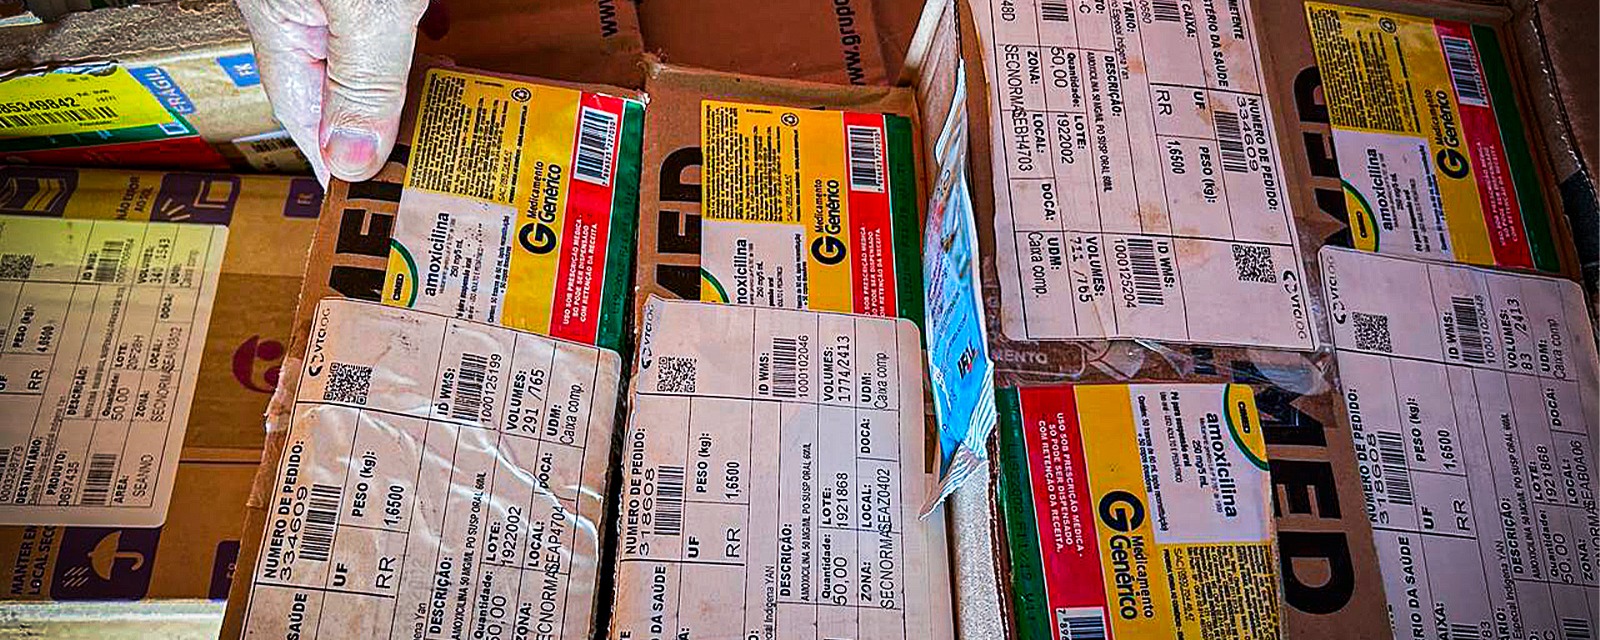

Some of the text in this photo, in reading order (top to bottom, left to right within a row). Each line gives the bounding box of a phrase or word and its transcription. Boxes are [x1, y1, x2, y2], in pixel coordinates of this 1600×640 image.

[833, 0, 866, 85] ww.grupo
[1183, 4, 1196, 38] CAIXA:
[1027, 51, 1040, 84] ZONA:
[1050, 47, 1068, 88] 50,00
[1067, 52, 1080, 107] Quantidade:
[1210, 34, 1228, 87] DA SAÚDE
[1104, 55, 1120, 117] DESCRIÇÃO:
[1156, 89, 1171, 116] RR
[1194, 91, 1205, 110] UF
[1033, 113, 1045, 153] LOCAL:
[1056, 112, 1074, 164] 1922002
[1074, 115, 1086, 149] LOTE:
[1237, 96, 1258, 172] 334609
[1424, 89, 1443, 145] Medicamento
[1436, 90, 1460, 147] Genérico
[1166, 140, 1185, 175] 1,6500
[1199, 146, 1212, 176] PESO
[1248, 98, 1278, 210] NUMERO DE PEDIDO:
[1436, 148, 1469, 179] G
[527, 161, 544, 219] Medicamento
[538, 164, 562, 224] Genérico
[814, 179, 824, 233] Medicamento
[822, 179, 841, 234] Genérico
[1041, 183, 1055, 221] DOCA:
[1366, 148, 1394, 231] amoxicilina
[423, 212, 449, 296] amoxicilina
[518, 223, 557, 255] G
[810, 236, 846, 265] G
[1027, 232, 1043, 262] Caixa
[1047, 237, 1061, 271] UDM:
[1073, 270, 1093, 303] /765
[1086, 237, 1105, 296] VOLUMES:
[1114, 239, 1136, 308] 1000125204
[1161, 257, 1174, 288] WMS:
[1444, 312, 1458, 343] WMS:
[1500, 309, 1518, 369] VOLUMES:
[759, 353, 769, 395] ID WMS:
[798, 335, 809, 398] 1000102046
[824, 347, 834, 401] VOLUMES:
[837, 335, 851, 402] 1774/2413
[1520, 353, 1534, 371] 83
[1538, 339, 1551, 372] UDM:
[28, 370, 45, 390] RR
[439, 368, 456, 399] WMS:
[481, 354, 502, 424] 1000125199
[506, 370, 526, 430] VOLUMES:
[522, 369, 544, 434] 291 /765
[861, 372, 871, 403] UDM:
[546, 404, 562, 436] UDM:
[1546, 387, 1562, 427] DOCA:
[560, 416, 577, 444] Caixa
[861, 419, 870, 454] DOCA:
[1038, 420, 1048, 440] COM
[1412, 428, 1426, 462] PESO
[1437, 430, 1458, 470] 1,6500
[46, 450, 67, 495] PRODUTO:
[539, 453, 552, 488] DOCA:
[696, 433, 712, 493] PESO (kg):
[1041, 443, 1055, 492] RETENÇÃO
[1056, 413, 1078, 512] USO SOB PRESCRIÇÃO
[1206, 412, 1237, 518] amoxicilina
[1348, 388, 1378, 522] NUMERO PEDIDO:
[1537, 445, 1558, 504] 1921868
[352, 451, 377, 517] PESO (kg):
[626, 428, 646, 554] NUMERO DE PEDIDO:
[725, 462, 741, 499] 1,6500
[802, 482, 811, 501] SUSP
[836, 473, 848, 527] 1921868
[1051, 438, 1073, 545] PODE SER DISPENSADO
[1366, 432, 1390, 525] 318608
[1529, 461, 1543, 500] LOTE:
[1562, 459, 1579, 505] LOCAL:
[264, 440, 304, 578] NUMERO DE PEDIDO:
[384, 485, 404, 526] 1,6500
[640, 468, 654, 556] 318608
[802, 503, 810, 514] PO
[823, 487, 832, 525] LOTE:
[862, 484, 871, 528] LOCAL:
[1098, 490, 1145, 531] G
[1421, 506, 1434, 530] UF
[1453, 500, 1470, 531] RR
[280, 486, 308, 581] 334609
[486, 521, 500, 561] LOTE:
[501, 506, 522, 566] 1922002
[528, 522, 544, 567] LOCAL:
[688, 536, 699, 558] UF
[726, 528, 740, 558] RR
[1539, 510, 1559, 577] Quantidade:
[11, 542, 31, 595] MANTER
[29, 554, 48, 596] LOCAL
[333, 563, 348, 586] UF
[376, 556, 396, 589] RR
[765, 566, 774, 585] YAN
[781, 524, 794, 596] DESCRIÇÃO:
[822, 534, 832, 599] Quantidade:
[833, 557, 849, 606] 50,00
[861, 561, 871, 602] ZONA:
[1109, 535, 1139, 620] Genérico
[1130, 536, 1154, 618] Medicamento
[1398, 536, 1420, 608] DA SAÚDE
[1578, 539, 1594, 581] ZONA:
[429, 557, 452, 634] DESCRIÇÃO:
[474, 571, 493, 639] Quantidade:
[651, 566, 666, 633] DA SAÚDE
[516, 603, 531, 640] ZONA:
